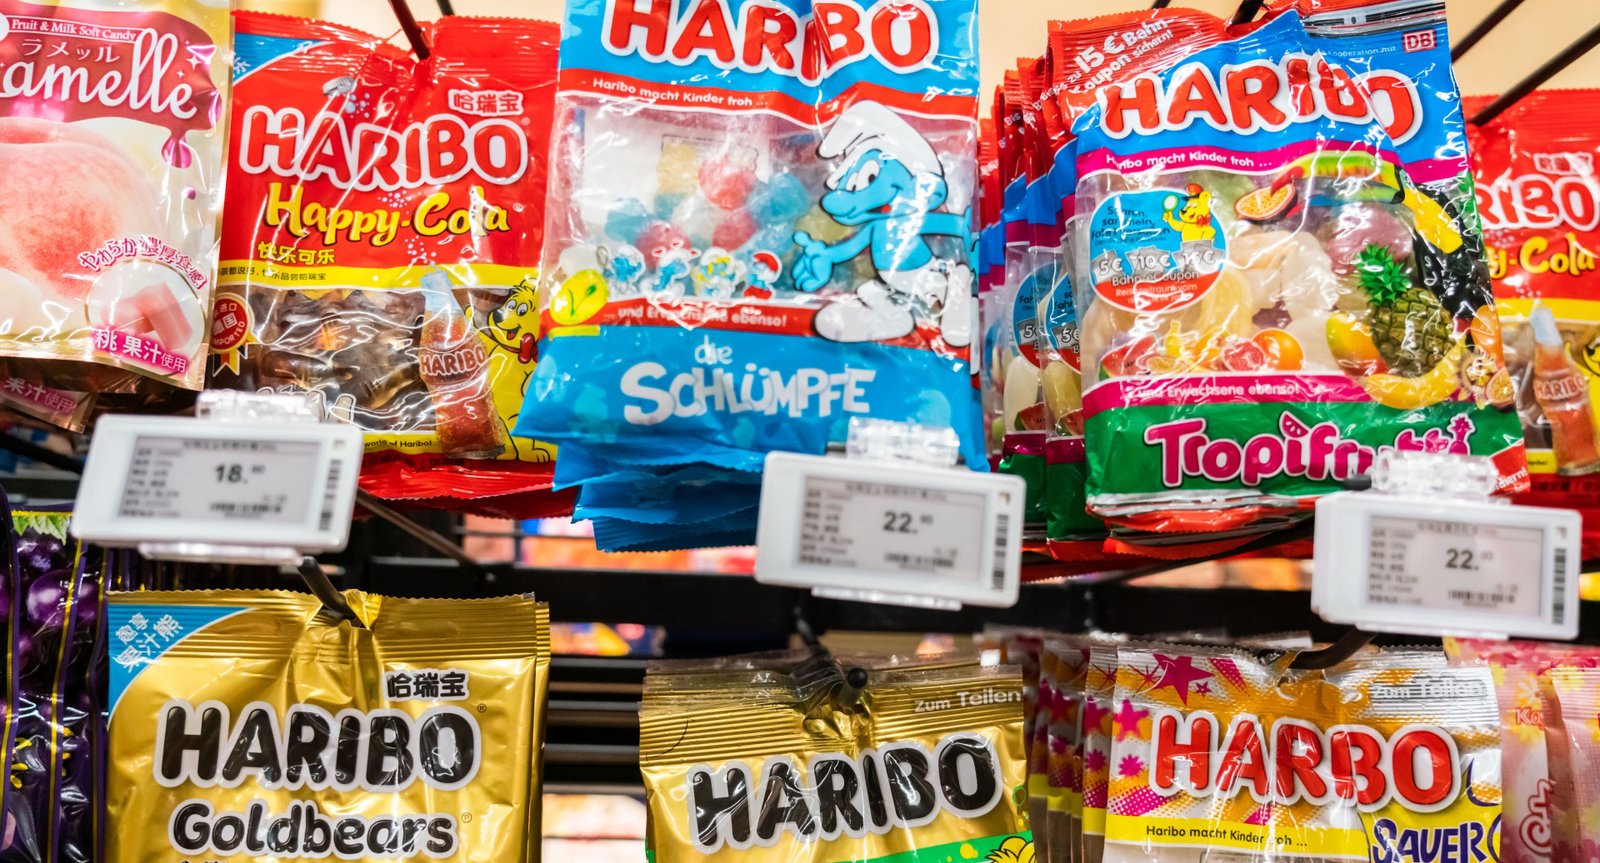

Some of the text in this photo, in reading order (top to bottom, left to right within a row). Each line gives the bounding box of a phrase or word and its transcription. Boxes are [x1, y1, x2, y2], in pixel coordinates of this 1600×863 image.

[11, 18, 136, 43] Fruit & Milk Soft Candy
[601, 0, 939, 86] HARIBO
[1132, 30, 1173, 58] sichern!
[1407, 33, 1432, 51] DB
[21, 38, 121, 64] ラメッル
[0, 27, 198, 120] amelle
[450, 88, 523, 117] 哈瑞宝
[592, 78, 636, 95] Haribo
[640, 86, 681, 102] macht
[683, 92, 724, 105] Kinder
[727, 95, 753, 107] froh
[240, 105, 528, 192] HARIBO
[1146, 153, 1185, 169] macht
[1189, 151, 1227, 164] Kinder
[1230, 155, 1254, 167] froh
[265, 182, 510, 247] Happy-Cola
[1474, 174, 1600, 231] RIBO
[1487, 232, 1596, 278] y-Cola
[618, 306, 643, 319] und
[731, 310, 787, 327] ebenso!
[213, 321, 245, 345] MPORTED
[420, 345, 487, 376] HARIBO
[694, 335, 732, 366] die
[620, 361, 877, 426] SCHLÜMPFE
[400, 440, 432, 448] Haribo!
[386, 670, 468, 699] 哈瑞宝
[915, 688, 1021, 713] Zum Teilen
[152, 700, 481, 792] HARIBO
[686, 732, 1004, 855] HARIBO
[168, 799, 458, 859] Goldbears
[1147, 825, 1186, 838] Haribo
[1189, 827, 1227, 840] macht
[1230, 830, 1263, 843] Kinder
[1373, 819, 1488, 863] SAUER
